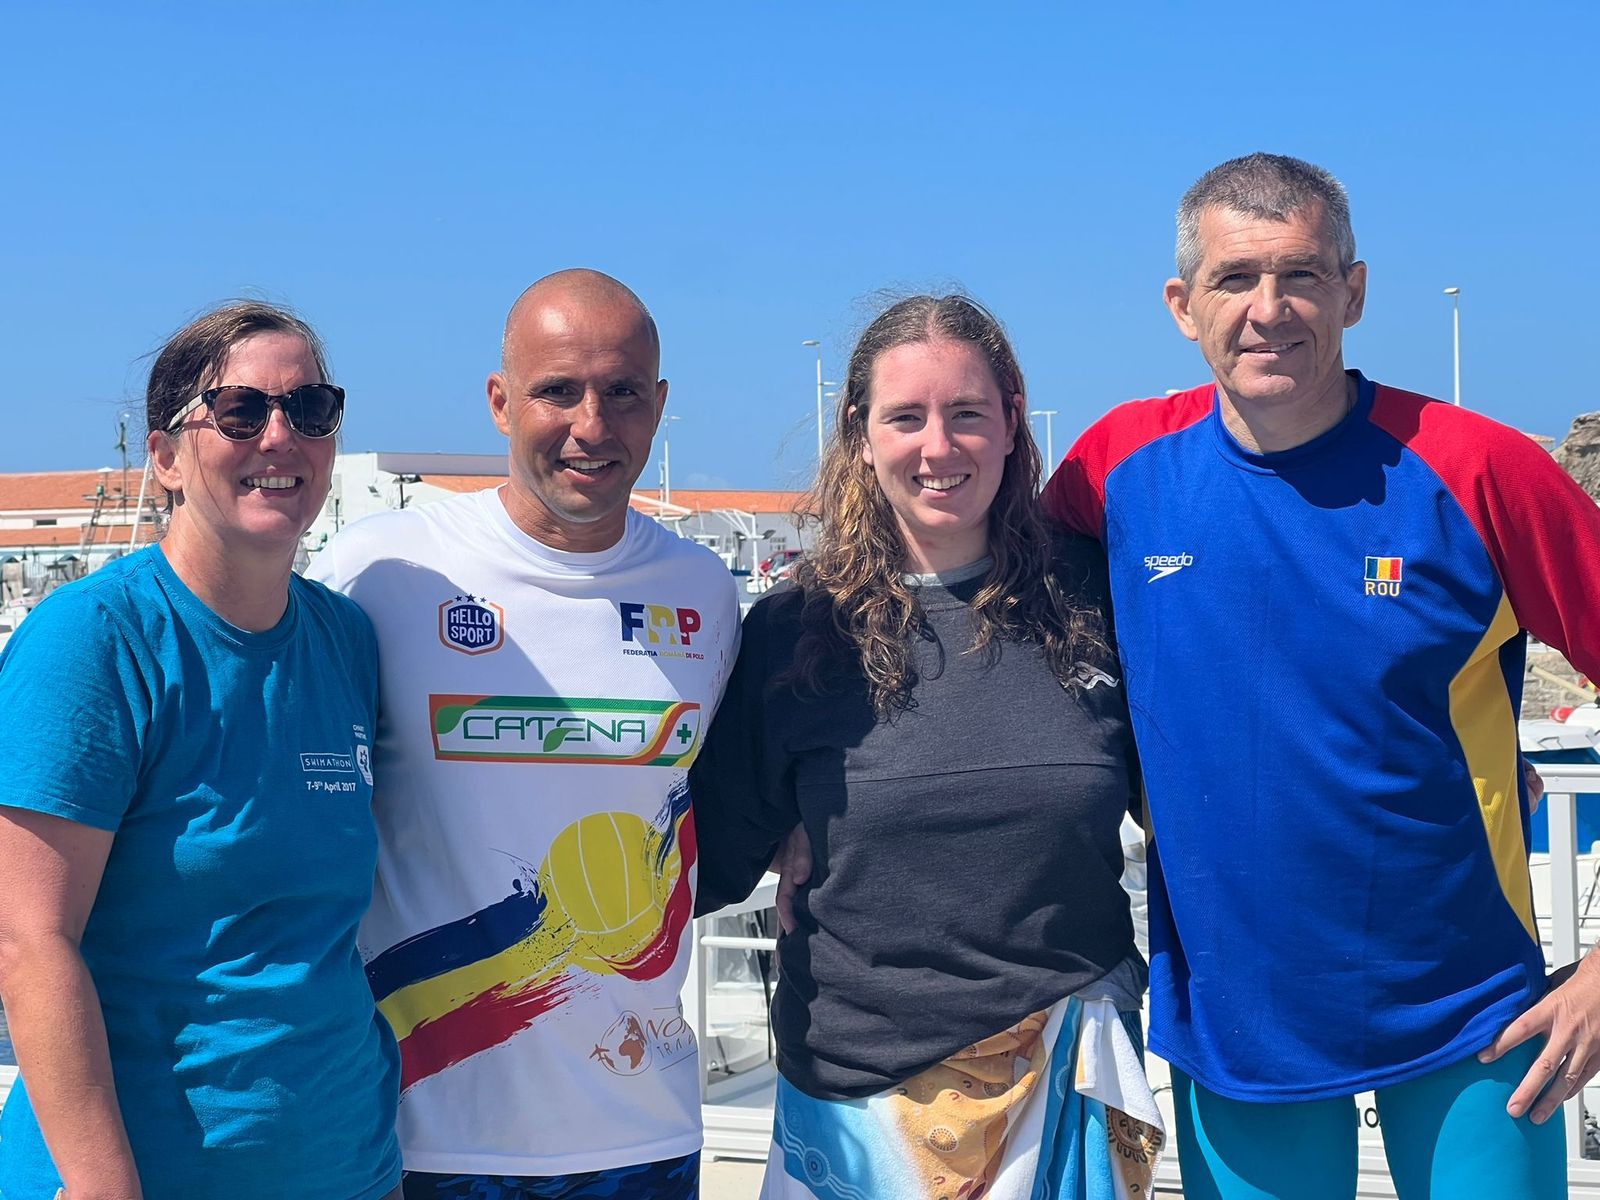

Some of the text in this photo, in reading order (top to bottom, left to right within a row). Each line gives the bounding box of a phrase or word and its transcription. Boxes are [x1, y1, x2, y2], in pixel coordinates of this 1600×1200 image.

[1144, 551, 1194, 571] speedo
[1365, 581, 1400, 597] ROU
[450, 608, 492, 626] HELLO
[450, 625, 493, 644] SPORT
[462, 715, 646, 744] CATENA
[324, 781, 341, 793] April
[341, 782, 356, 792] 2017
